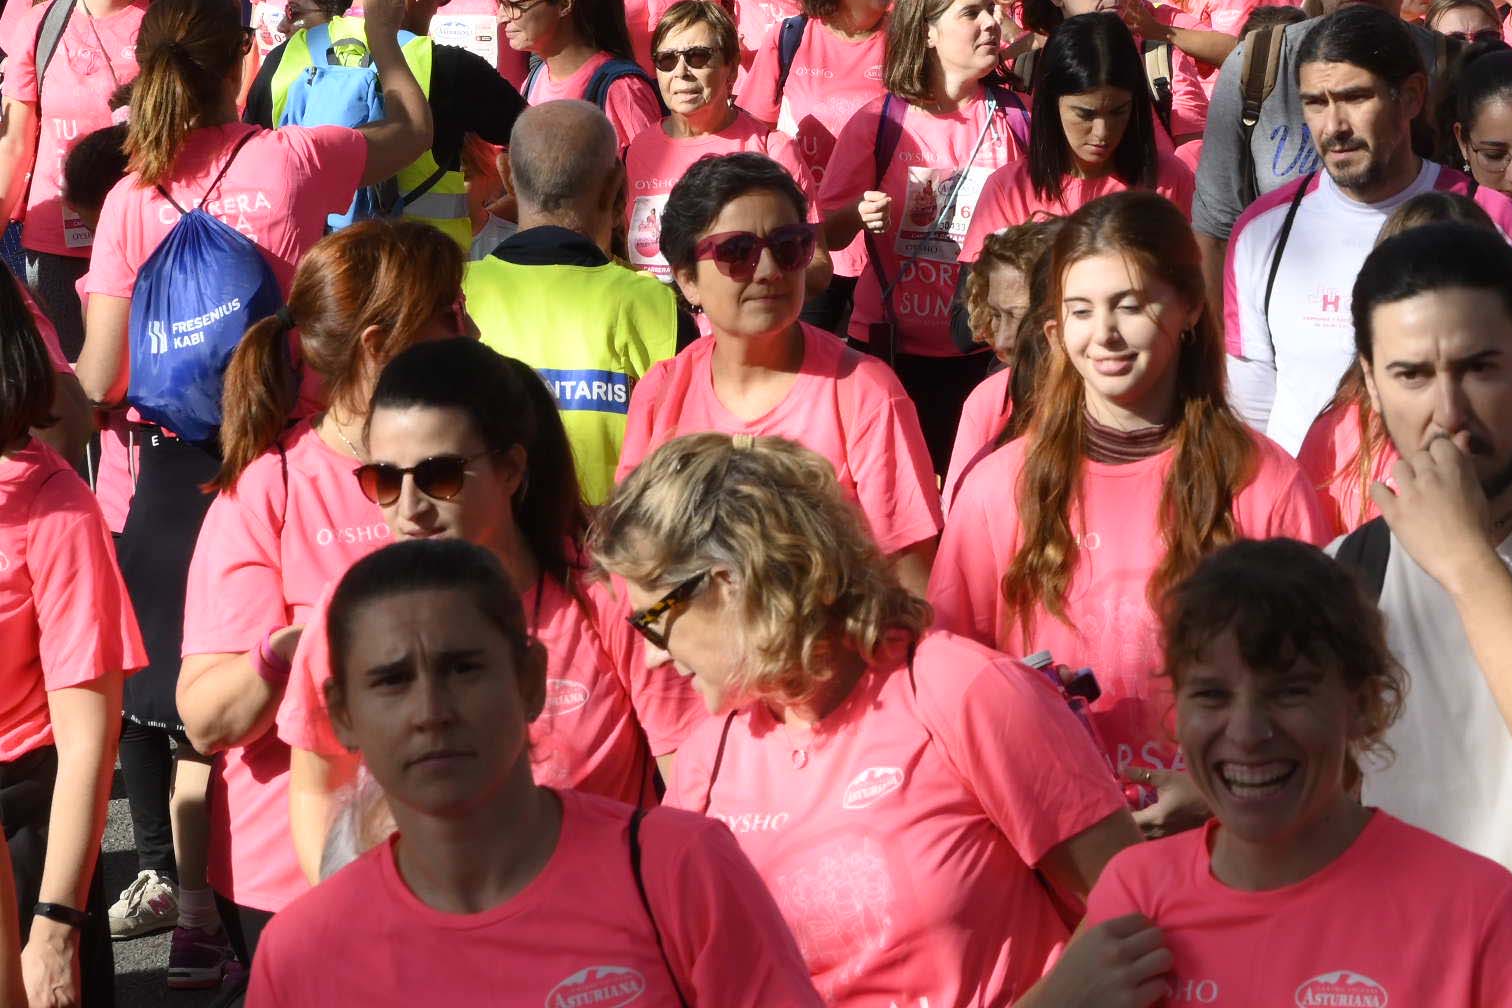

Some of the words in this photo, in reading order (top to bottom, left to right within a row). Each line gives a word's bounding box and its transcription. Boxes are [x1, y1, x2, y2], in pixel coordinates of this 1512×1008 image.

[172, 298, 241, 334] FRESENIUS
[174, 331, 204, 350] KABI
[556, 980, 640, 1008] ASTURIANA
[1303, 988, 1381, 1008] ASTURIANA
